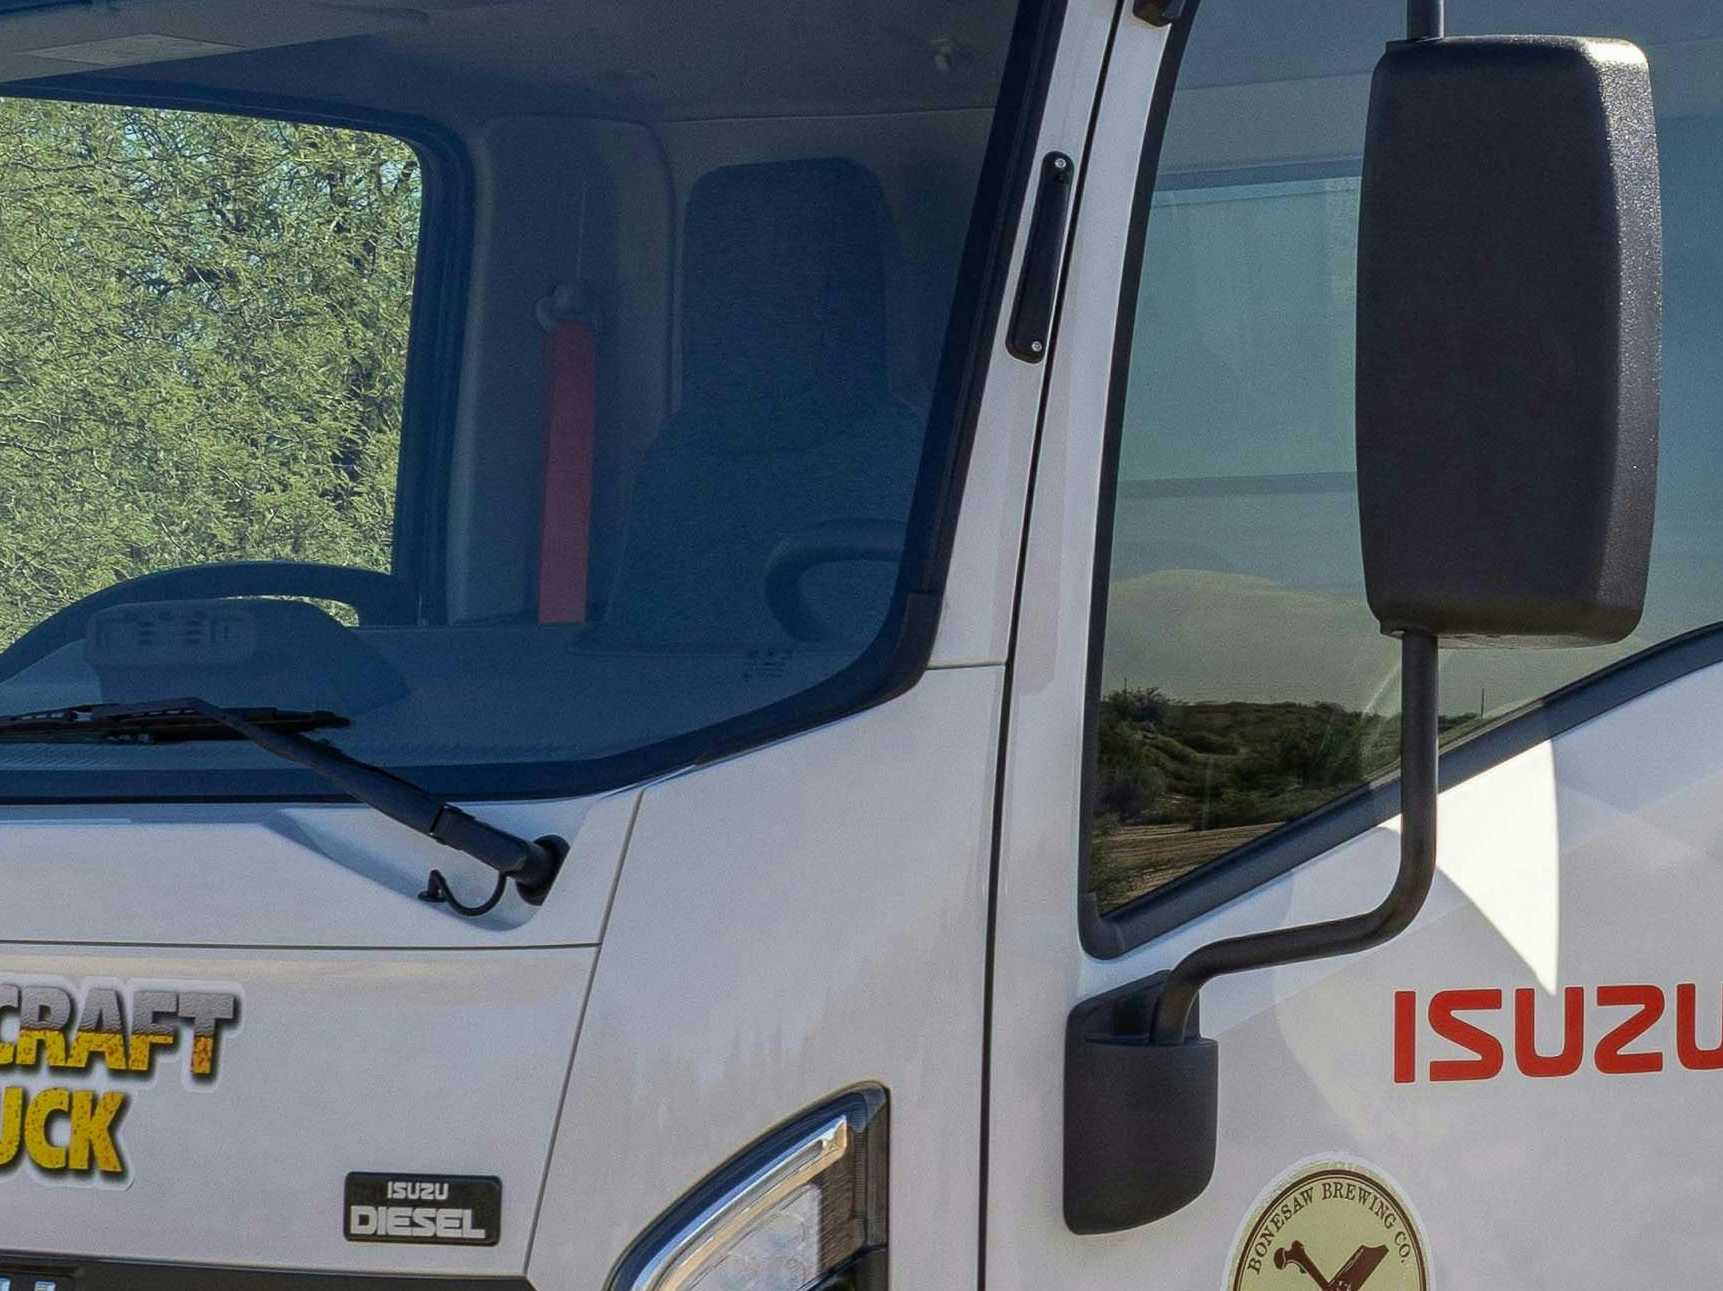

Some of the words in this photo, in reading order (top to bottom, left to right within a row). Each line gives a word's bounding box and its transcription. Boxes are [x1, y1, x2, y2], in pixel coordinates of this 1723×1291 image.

[386, 1180, 449, 1202] ISUZU
[350, 1204, 486, 1240] DIESEL
[1247, 1186, 1315, 1275] BONESAW
[1321, 1180, 1396, 1231] BREWING
